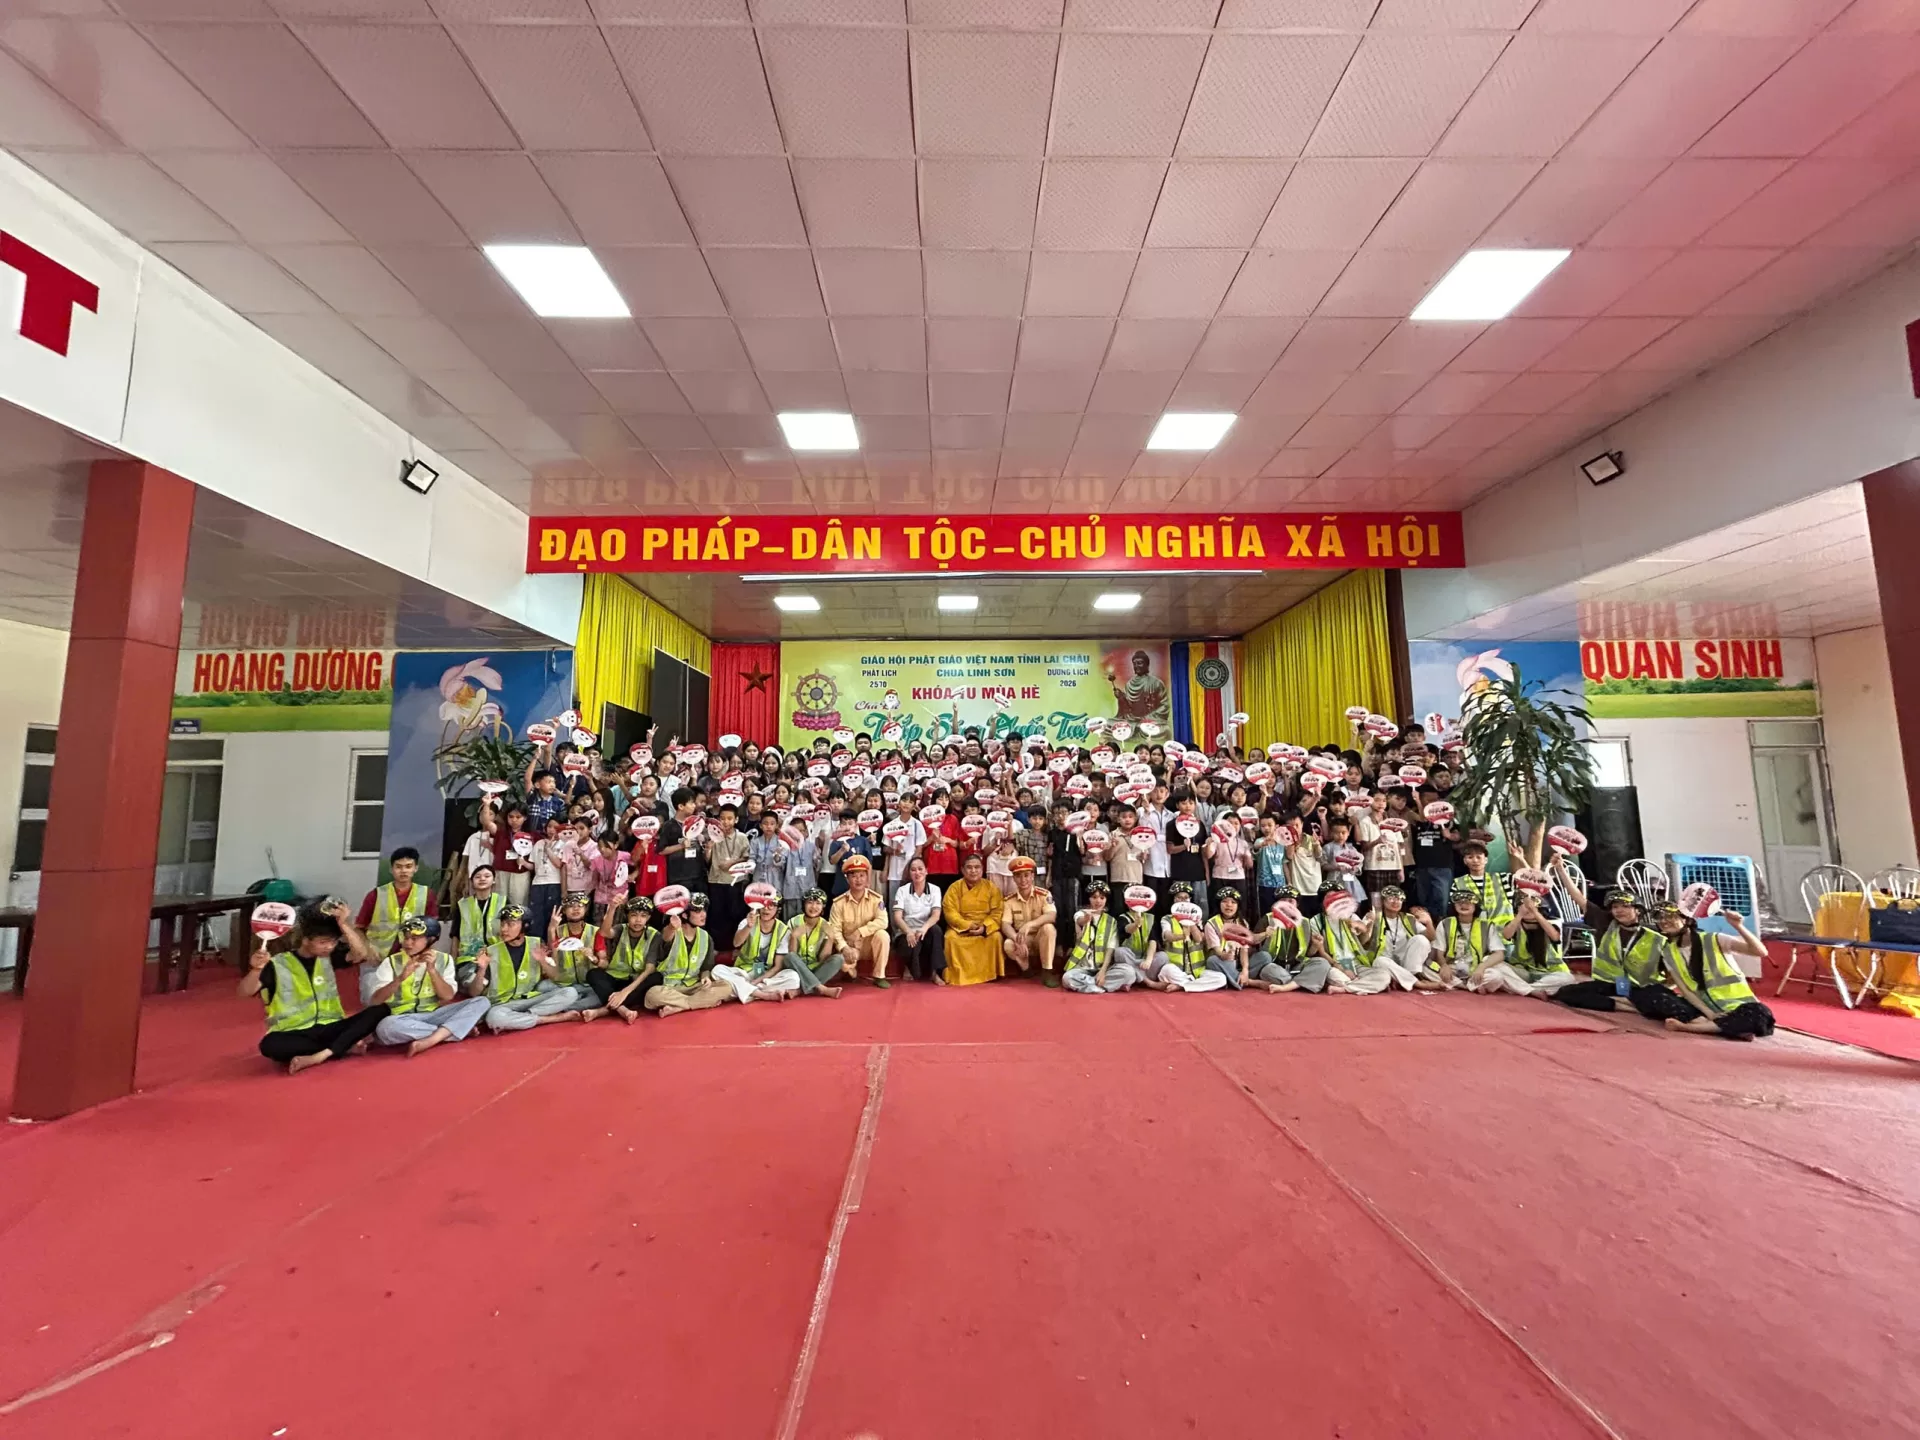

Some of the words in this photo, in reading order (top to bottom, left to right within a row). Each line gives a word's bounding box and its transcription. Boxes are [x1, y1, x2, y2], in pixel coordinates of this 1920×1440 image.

[540, 528, 626, 569] ĐẠO
[1124, 516, 1265, 558] NGHĨA
[1285, 516, 1346, 557] XÃ
[1366, 516, 1440, 565] HỘI
[292, 646, 383, 692] DƯƠNG
[888, 654, 906, 666] HỘI
[965, 654, 987, 666] VIỆT
[990, 655, 1014, 664] NAM
[1044, 655, 1059, 664] LAI
[967, 669, 991, 677] LINH
[1580, 641, 1684, 684] QUAN
[1694, 640, 1784, 679] SINH
[1021, 684, 1040, 699] HÈ
